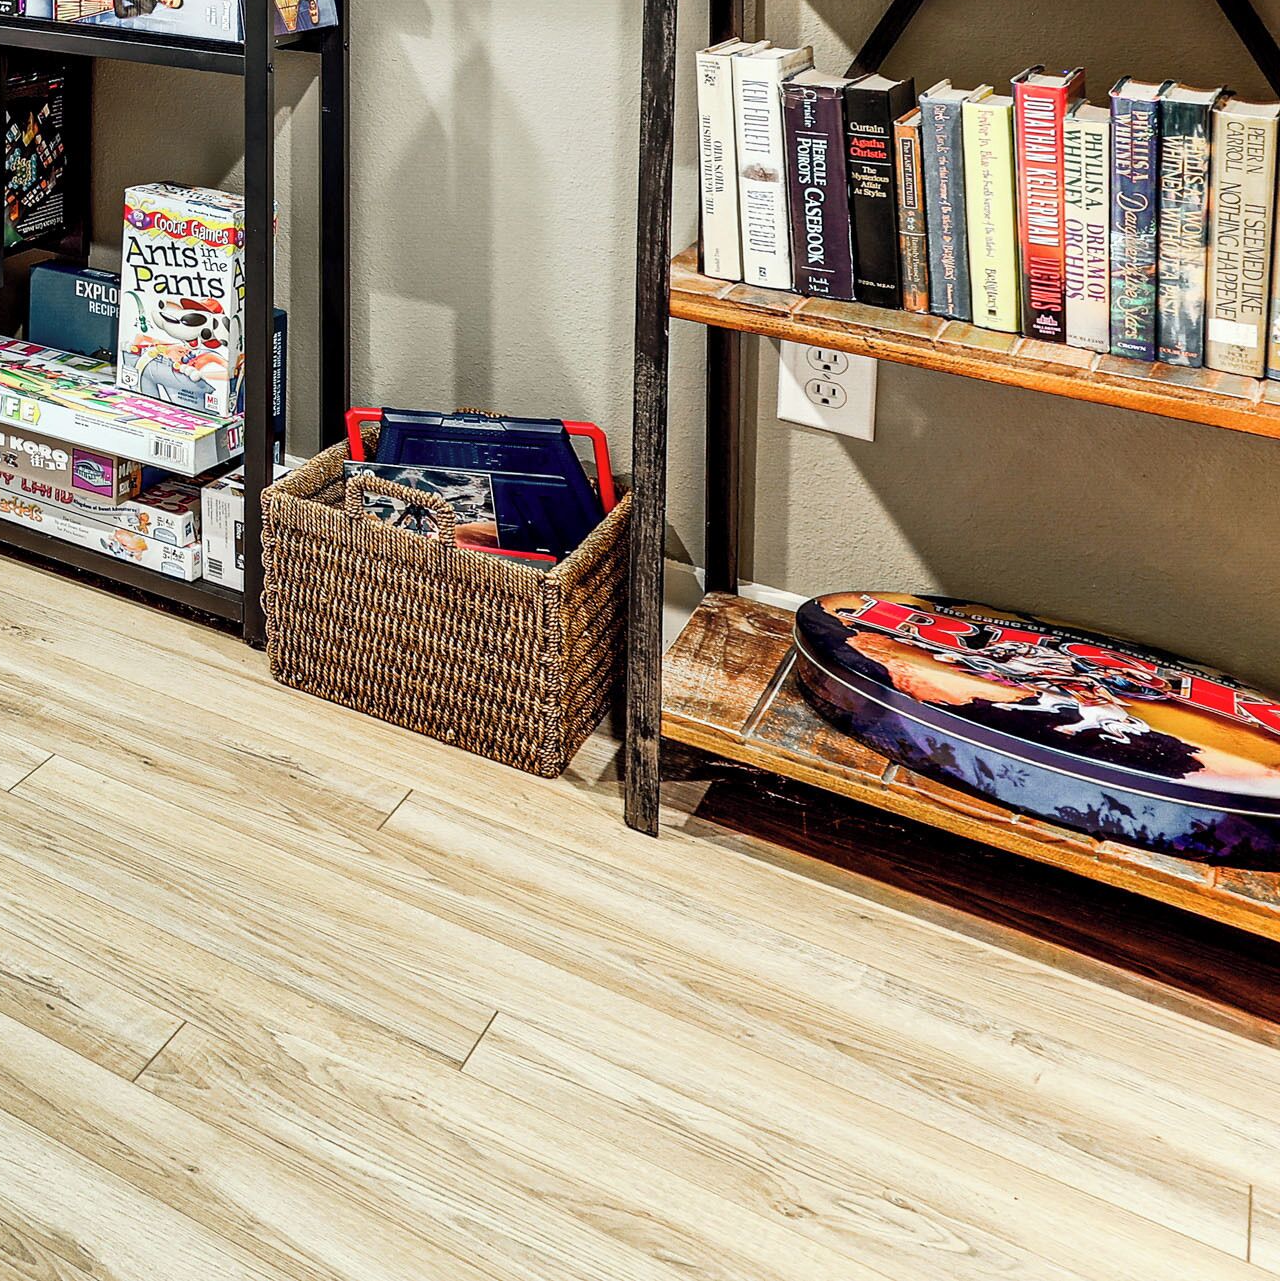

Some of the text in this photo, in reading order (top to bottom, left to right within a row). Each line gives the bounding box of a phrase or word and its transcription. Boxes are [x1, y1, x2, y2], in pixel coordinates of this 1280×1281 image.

[742, 79, 770, 154] KEN FOLLETT
[802, 89, 818, 128] Christie
[850, 122, 884, 134] Curtain
[851, 138, 885, 151] Agatha
[811, 138, 828, 187] HERCULE
[850, 147, 887, 160] Christie
[905, 155, 913, 173] LAST
[1226, 122, 1244, 172] CARROLL
[703, 115, 715, 215] THE AGATHA CHRISTIE
[851, 173, 889, 184] Mysterious
[862, 166, 877, 174] The
[1024, 94, 1059, 246] JONATHAN KELLERMAN
[1065, 130, 1082, 209] WHITNEY
[1085, 132, 1103, 210] PHYLLIS A.
[1162, 136, 1184, 198] WHITNEY
[860, 182, 881, 190] Affair
[865, 189, 887, 199] Styles
[906, 175, 915, 206] LECTURE
[154, 214, 229, 245] Cootie Games
[804, 187, 825, 265] CASEBOOK
[126, 236, 218, 269] Ants in
[203, 259, 227, 273] the
[1065, 219, 1084, 300] ORCHIDS
[1087, 223, 1105, 303] DREAM OF
[1216, 181, 1241, 322] NOTHING HAPPENE
[1241, 205, 1266, 316] IT SEEMED LIKE
[130, 264, 226, 299] Pants
[1029, 256, 1062, 311] VICTIMS
[1117, 342, 1146, 352] CROWN
[10, 435, 69, 463] KORO
[21, 477, 75, 505] LAND
